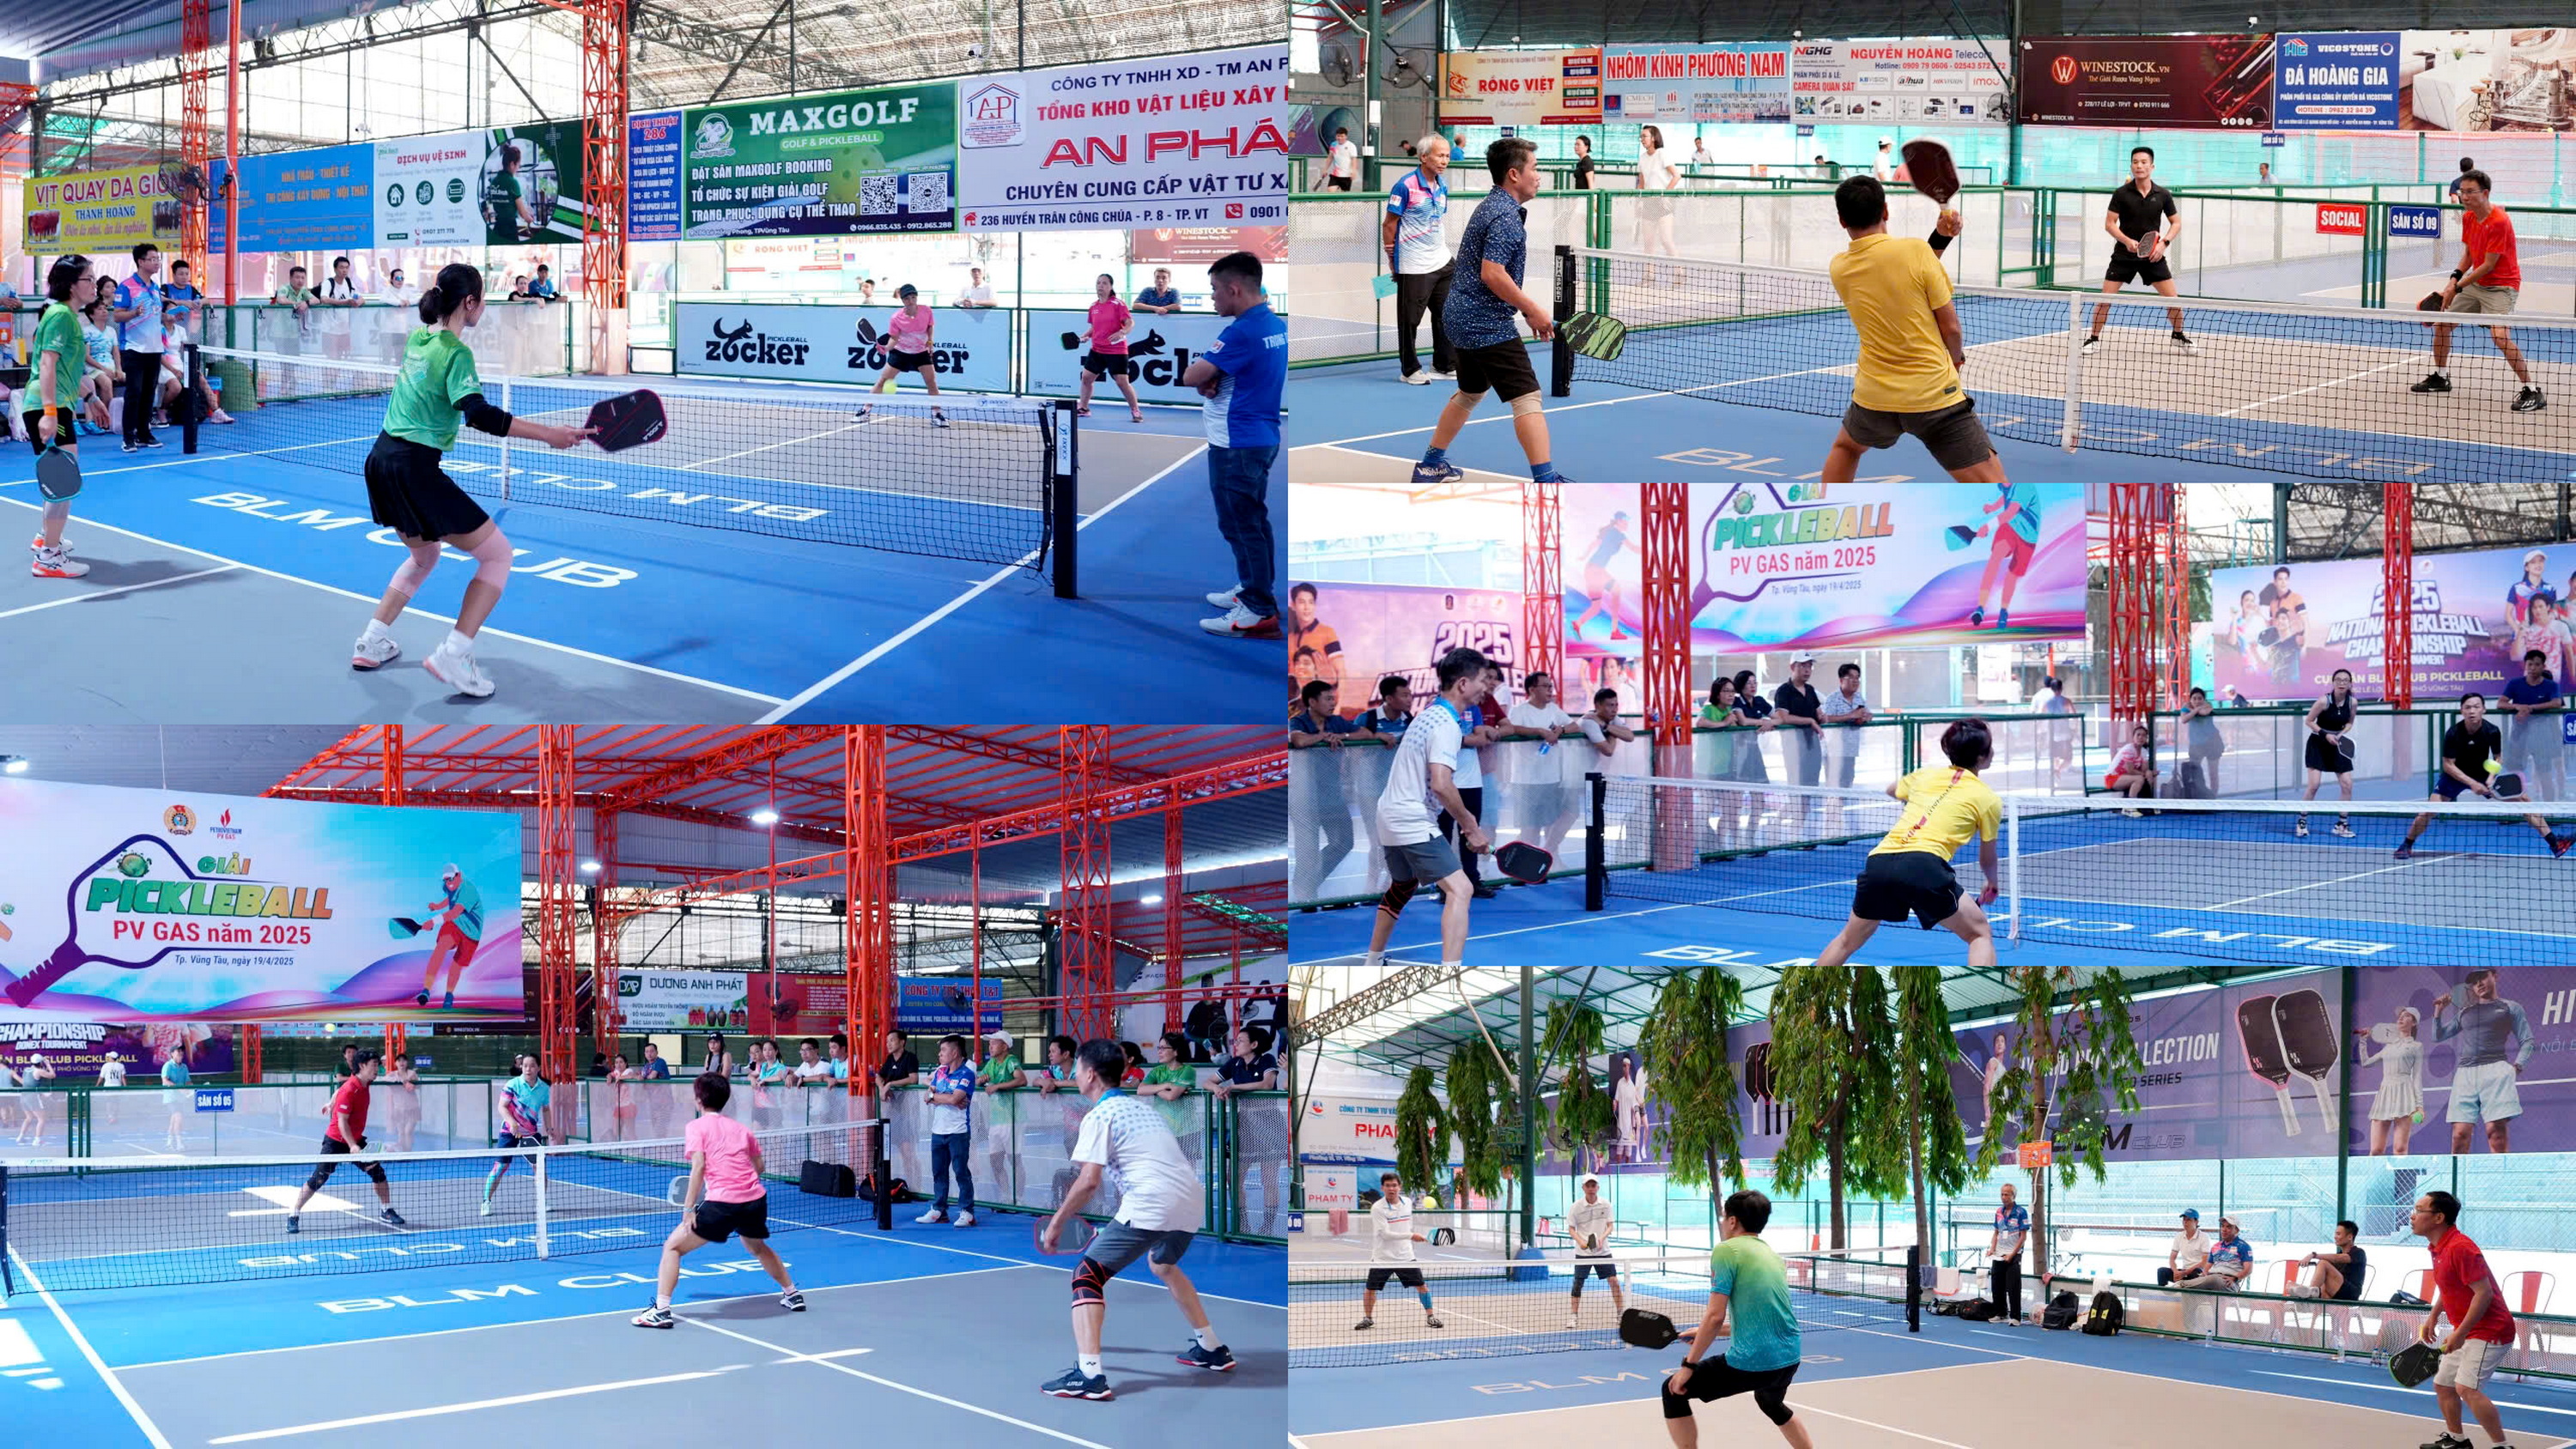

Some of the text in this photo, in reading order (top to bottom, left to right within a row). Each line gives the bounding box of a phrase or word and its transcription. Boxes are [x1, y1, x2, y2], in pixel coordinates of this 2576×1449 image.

[1850, 44, 1903, 59] NGUYỄN
[1907, 45, 1953, 59] HOÀNG
[2318, 44, 2379, 52] VICOSTONE
[1051, 59, 1273, 91] CÔNG TY TNHH XD TM AN
[1607, 49, 1786, 81] NHÔM KÍNH PHƯƠNG NAM
[2081, 61, 2170, 73] WINESTOCK.VN
[2285, 64, 2389, 85] ĐÁ HOÀNG GIA
[1793, 81, 1856, 92] CAMERA QUAN SÁT
[1037, 85, 1276, 121] TỔNG KHO VẬT LIỆU XÂY
[632, 116, 678, 130] DỊCH THUẬT
[750, 97, 919, 136] MAXGOLF
[644, 128, 666, 140] 286
[782, 133, 879, 149] GOLF & PICKLEBALL
[397, 149, 466, 166] DỊCH VỤ VỆ SINH
[1040, 134, 1127, 169] AN
[692, 166, 710, 182] ĐẶT
[713, 164, 732, 179] SÂN
[735, 161, 782, 178] MAXGOLF
[786, 159, 832, 175] BOOKING
[35, 176, 134, 208] VỊT QUAY DA
[692, 181, 829, 202] TỔ CHỨC SỰ KIỆN GIẢI GOLF
[1005, 173, 1265, 200] CHUYÊN CUNG CẤP VẬT TƯ
[692, 209, 723, 222] TRANG
[757, 204, 783, 222] DỤNG
[788, 204, 802, 221] CỤ
[806, 199, 825, 218] THỂ
[829, 203, 856, 216] THAO
[981, 215, 999, 226] 236
[1038, 211, 1066, 224] TRÂN
[1069, 210, 1099, 223] CÔNG
[1102, 209, 1133, 222] CHÚA
[1157, 210, 1163, 221] 8
[1176, 209, 1192, 221] TP.
[1195, 209, 1209, 220] VT
[1250, 206, 1279, 218] 0901
[2320, 209, 2361, 227] SOCIAL
[2392, 211, 2437, 230] SÂN SỐ 09
[705, 333, 810, 366] zocker
[188, 492, 374, 532] BLM
[628, 488, 831, 523] BLM
[1713, 502, 1895, 551] PICKLEBALL
[1730, 546, 1876, 575] PV GAS năm 2025
[1830, 580, 1862, 591] 19/4/2025
[2430, 670, 2505, 682] PICKLEBALL
[197, 852, 251, 875] GIẢI
[86, 877, 333, 919] PICKLEBALL
[113, 920, 311, 945] PV GAS năm 2025
[175, 955, 294, 967] Tp. Vũng Tàu, ngày 19/4/2025
[650, 977, 743, 991] DƯƠNG ANH PHÁT
[905, 982, 928, 996] CÔNG
[931, 985, 940, 996] TY
[41, 1040, 88, 1050] TOURNAMENT
[2140, 1072, 2182, 1088] SERIES
[197, 1094, 212, 1107] SÂN
[215, 1092, 222, 1107] SỐ
[2131, 1134, 2186, 1150] CLUB
[1309, 1194, 1338, 1203] PHAM
[317, 1283, 541, 1313] BLM
